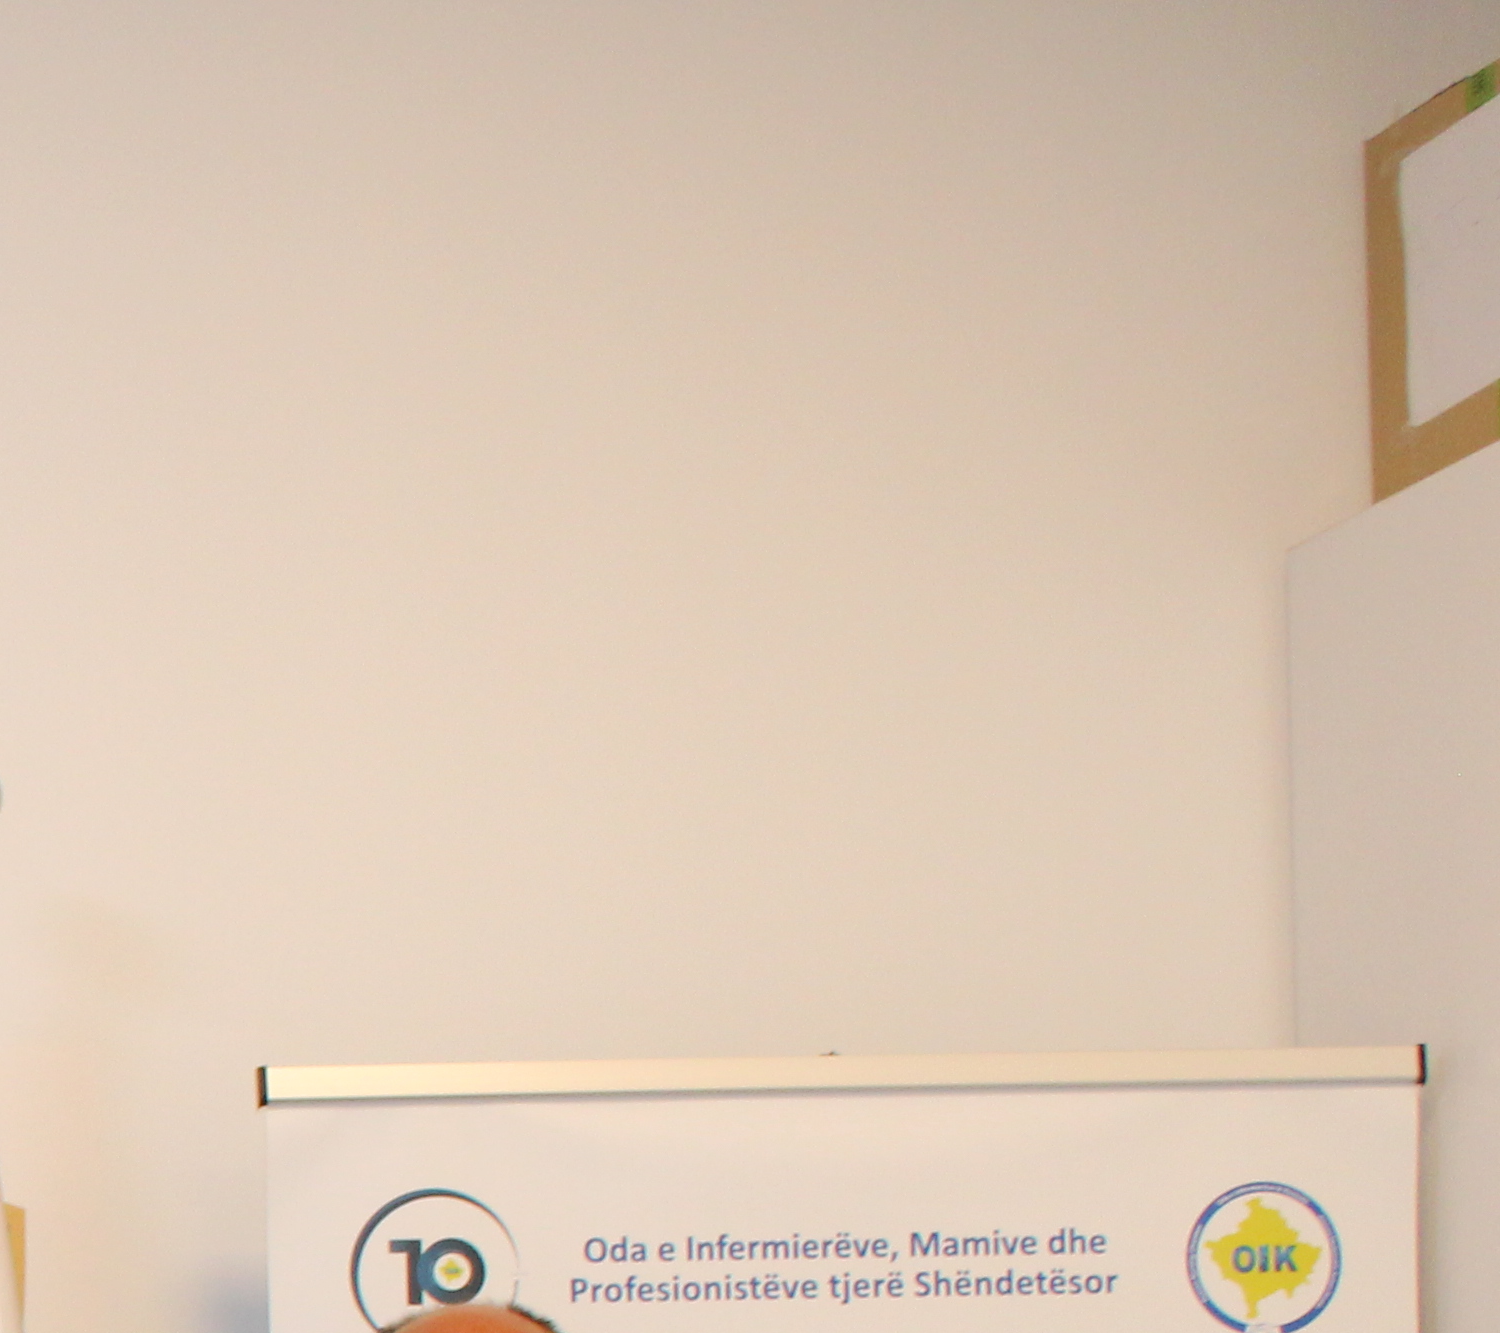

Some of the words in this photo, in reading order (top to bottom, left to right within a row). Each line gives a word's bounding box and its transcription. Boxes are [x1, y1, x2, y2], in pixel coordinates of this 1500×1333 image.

[583, 1235, 649, 1264] Oda
[658, 1241, 677, 1262] e
[687, 1232, 900, 1263] Infermierëve,
[910, 1229, 1039, 1258] Mamive
[1049, 1227, 1108, 1256] dhe
[1232, 1243, 1299, 1274] OIK
[570, 1273, 821, 1304] Profesionistëve
[828, 1271, 905, 1305] tjerë
[914, 1268, 1120, 1299] Shëndetësor
